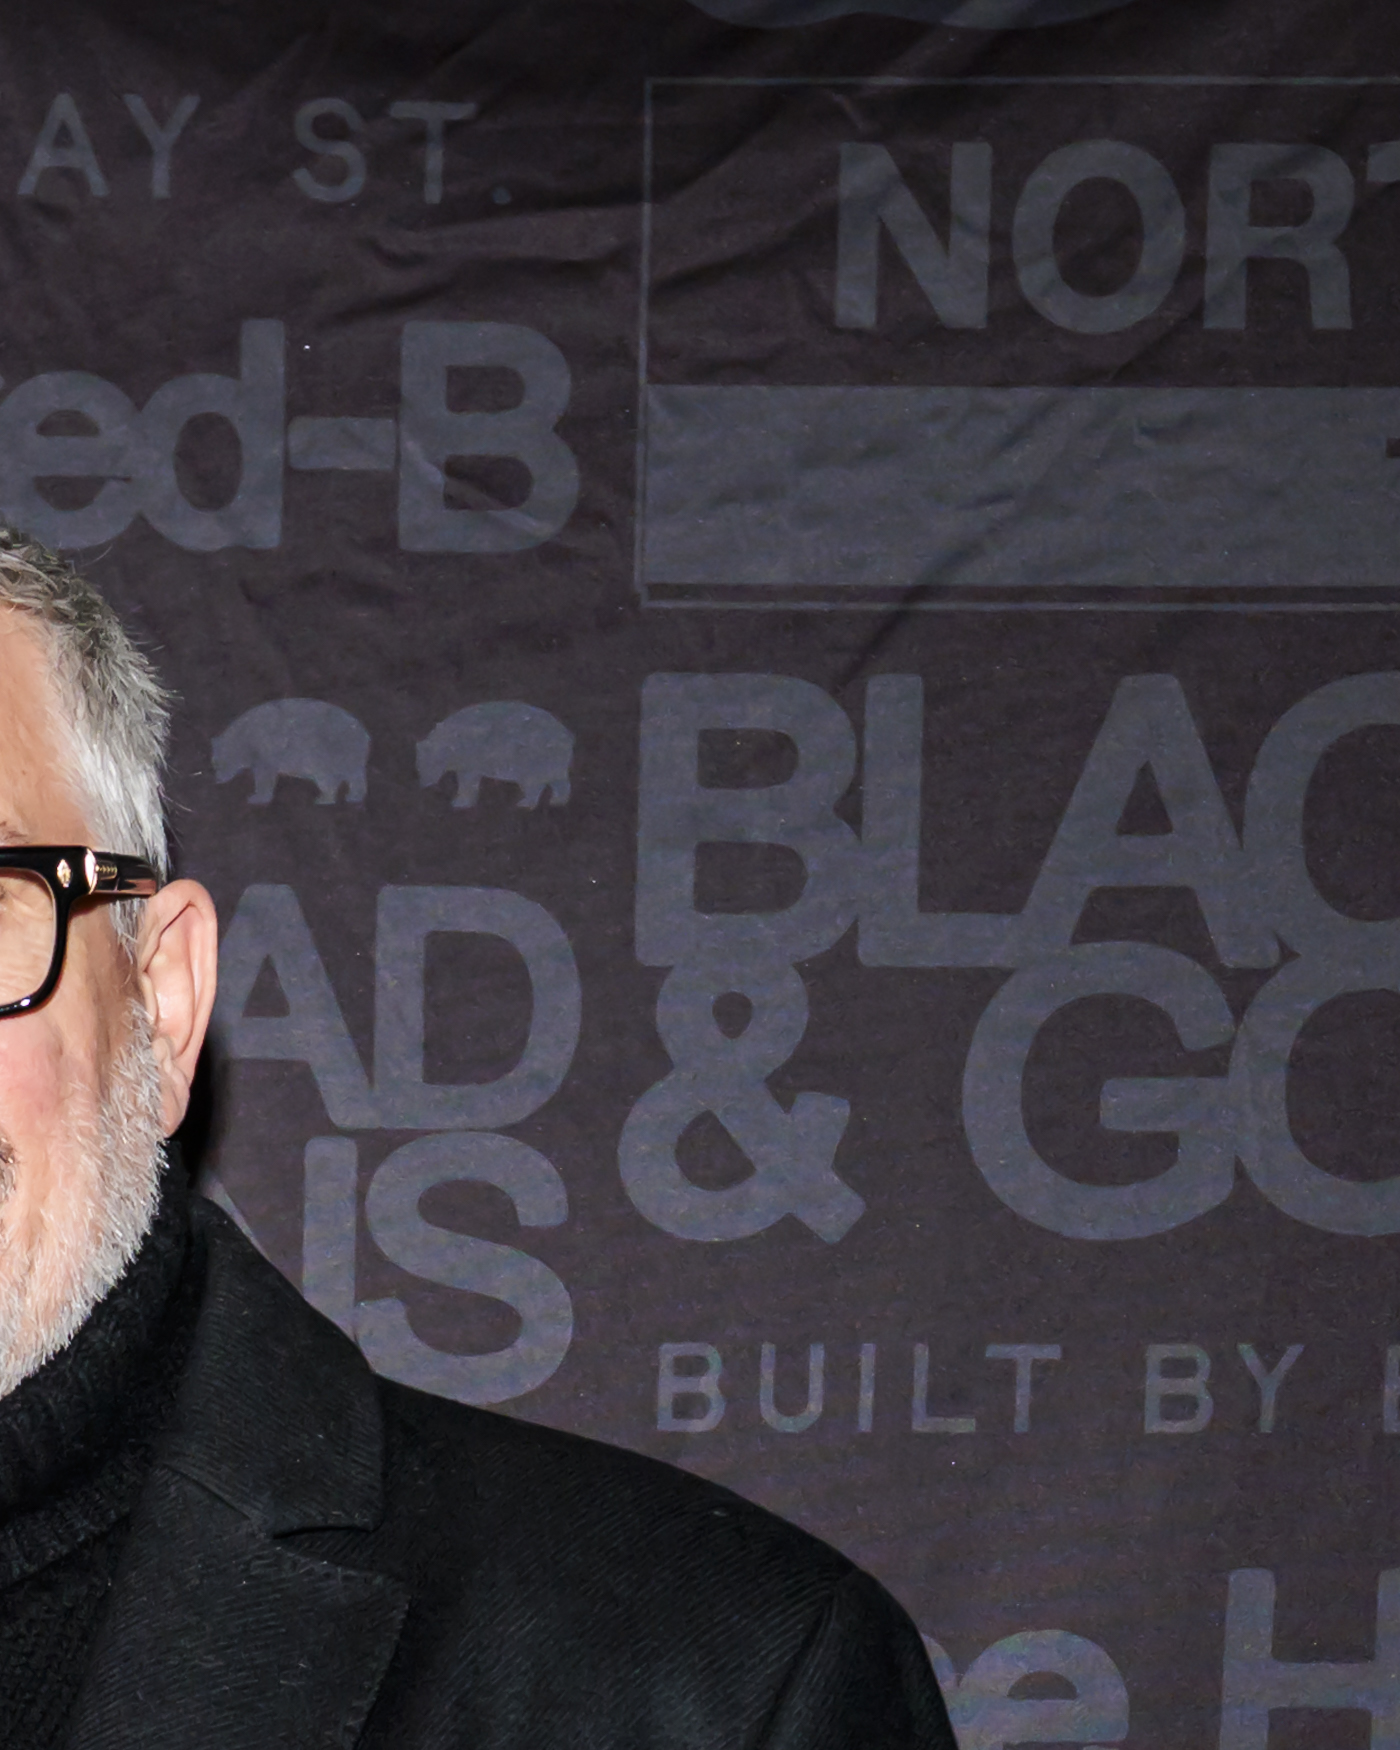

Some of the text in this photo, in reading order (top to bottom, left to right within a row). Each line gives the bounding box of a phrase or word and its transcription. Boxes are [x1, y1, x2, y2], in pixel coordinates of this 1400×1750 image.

[292, 96, 516, 207] ST.
[655, 1340, 1065, 1435] BUILT
[1142, 1342, 1306, 1435] BY
